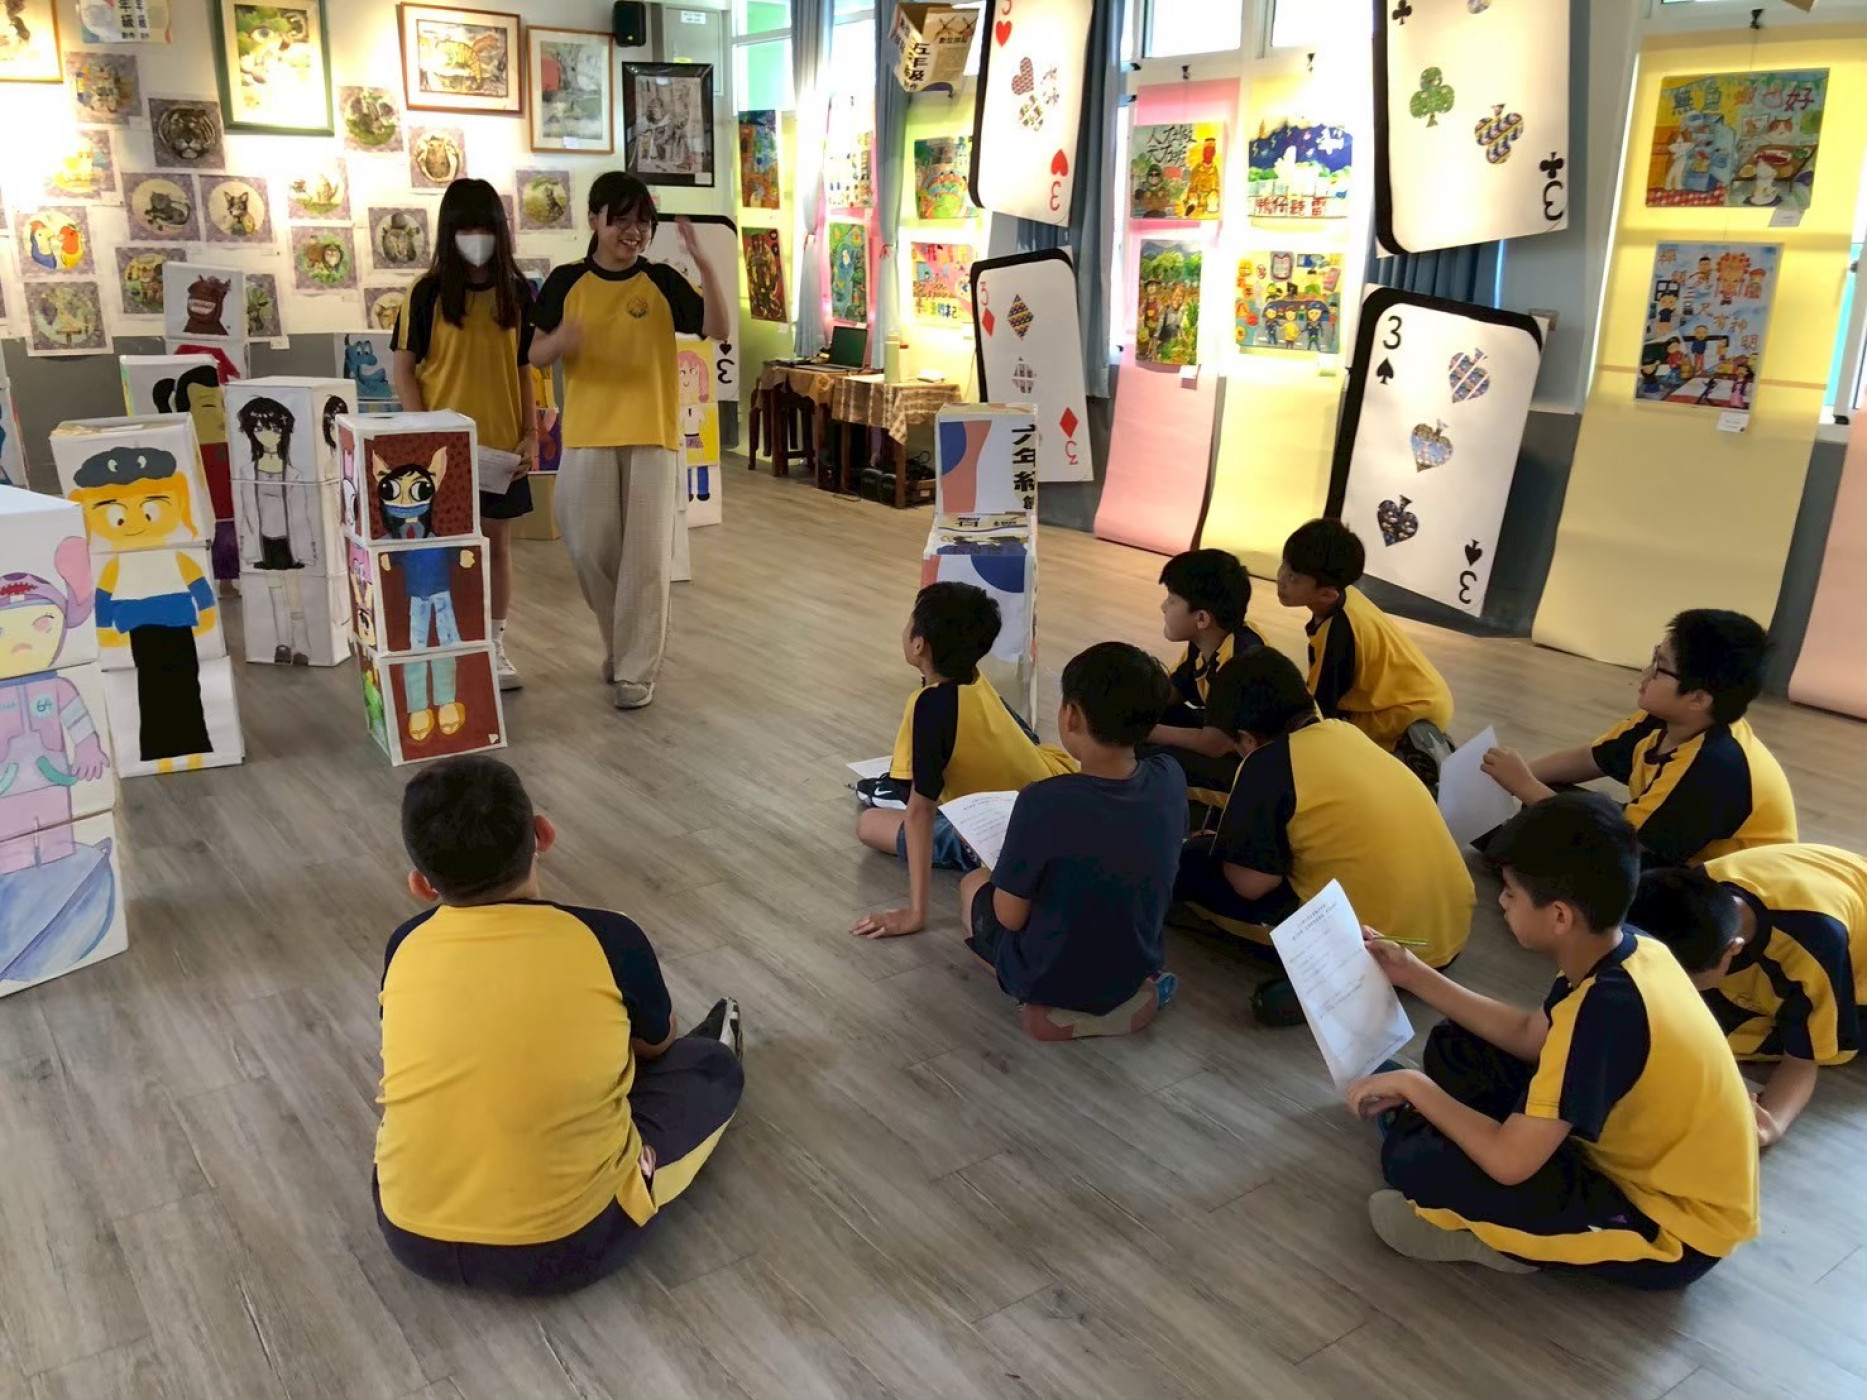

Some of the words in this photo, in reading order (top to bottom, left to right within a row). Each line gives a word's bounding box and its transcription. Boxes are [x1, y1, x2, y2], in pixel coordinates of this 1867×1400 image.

[1050, 181, 1062, 211] 3
[1543, 180, 1564, 221] 3
[980, 281, 990, 307] 3
[1383, 315, 1402, 350] 3
[716, 358, 735, 384] 3
[1065, 441, 1078, 465] 3
[1458, 570, 1478, 605] 3
